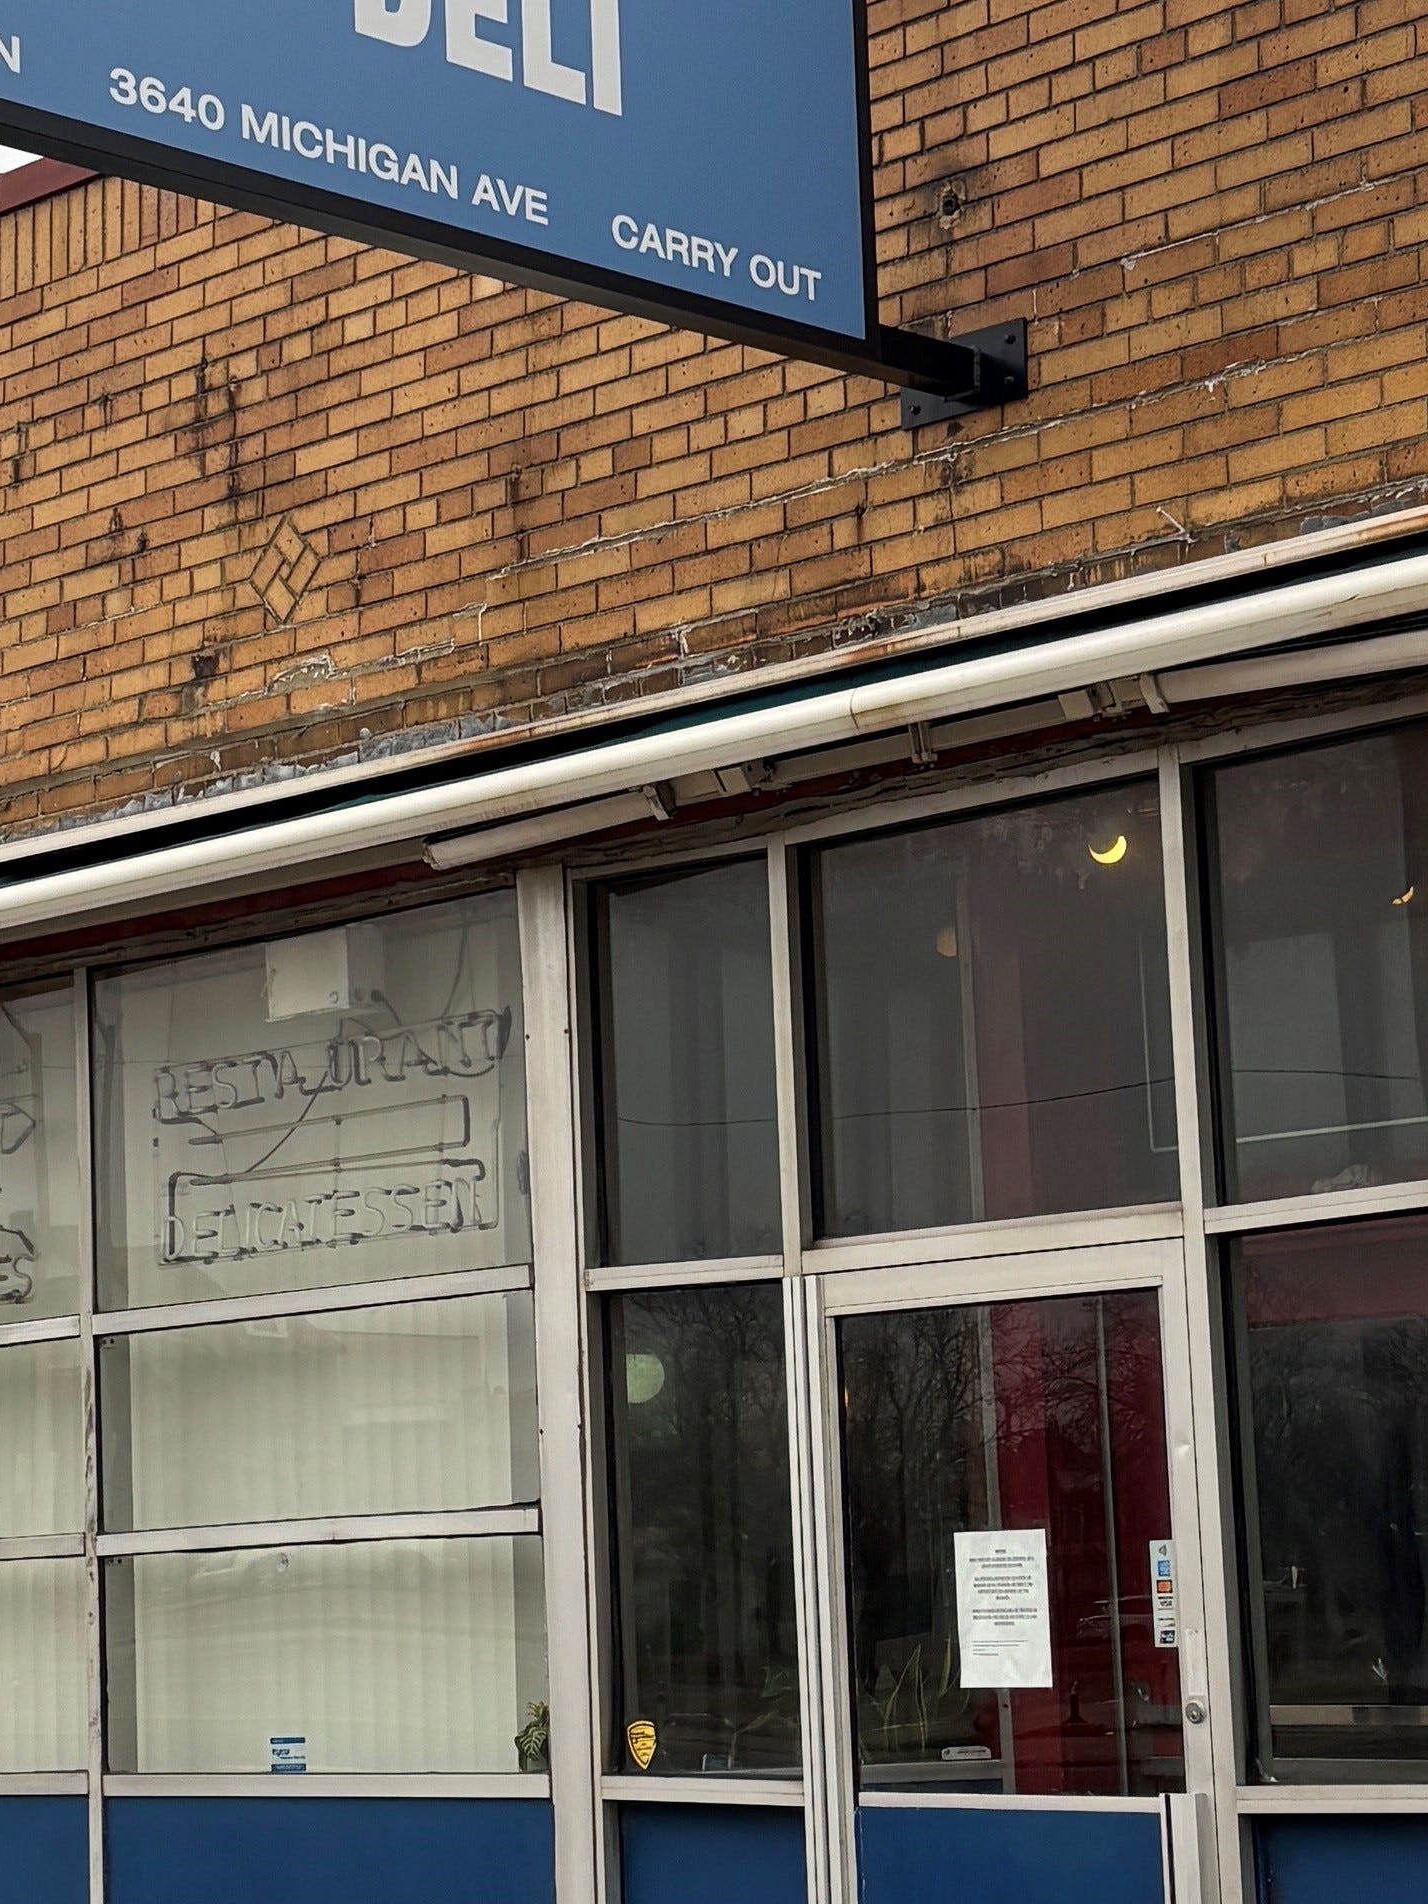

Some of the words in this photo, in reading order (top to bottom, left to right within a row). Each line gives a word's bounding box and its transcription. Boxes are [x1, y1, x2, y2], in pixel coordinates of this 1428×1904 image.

[109, 67, 226, 131] 3640
[241, 103, 458, 200] MICHIGAN
[472, 174, 549, 226] AVE
[611, 214, 738, 278] CARRY
[749, 254, 822, 301] OUT
[162, 1178, 490, 1262] DELICATESSEN
